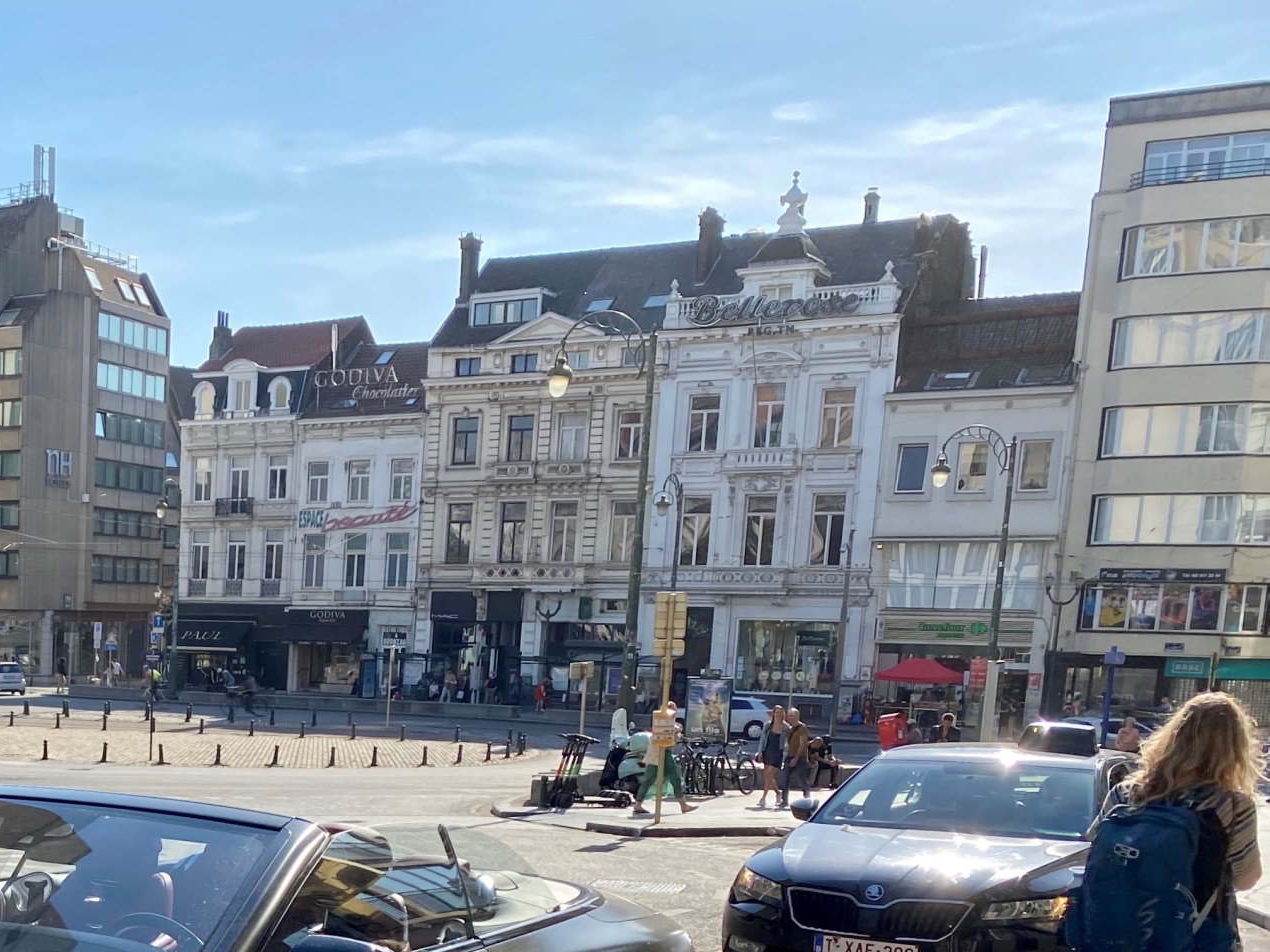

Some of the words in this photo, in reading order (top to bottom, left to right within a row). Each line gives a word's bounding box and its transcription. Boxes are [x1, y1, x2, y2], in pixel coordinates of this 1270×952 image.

[686, 293, 860, 327] Bellerose
[314, 366, 399, 388] GODIVA
[352, 382, 420, 400] Chocolatier
[298, 509, 324, 529] ESPACE
[310, 610, 346, 619] GODIVA
[181, 630, 222, 640] PAUL
[1175, 663, 1201, 671] BASE
